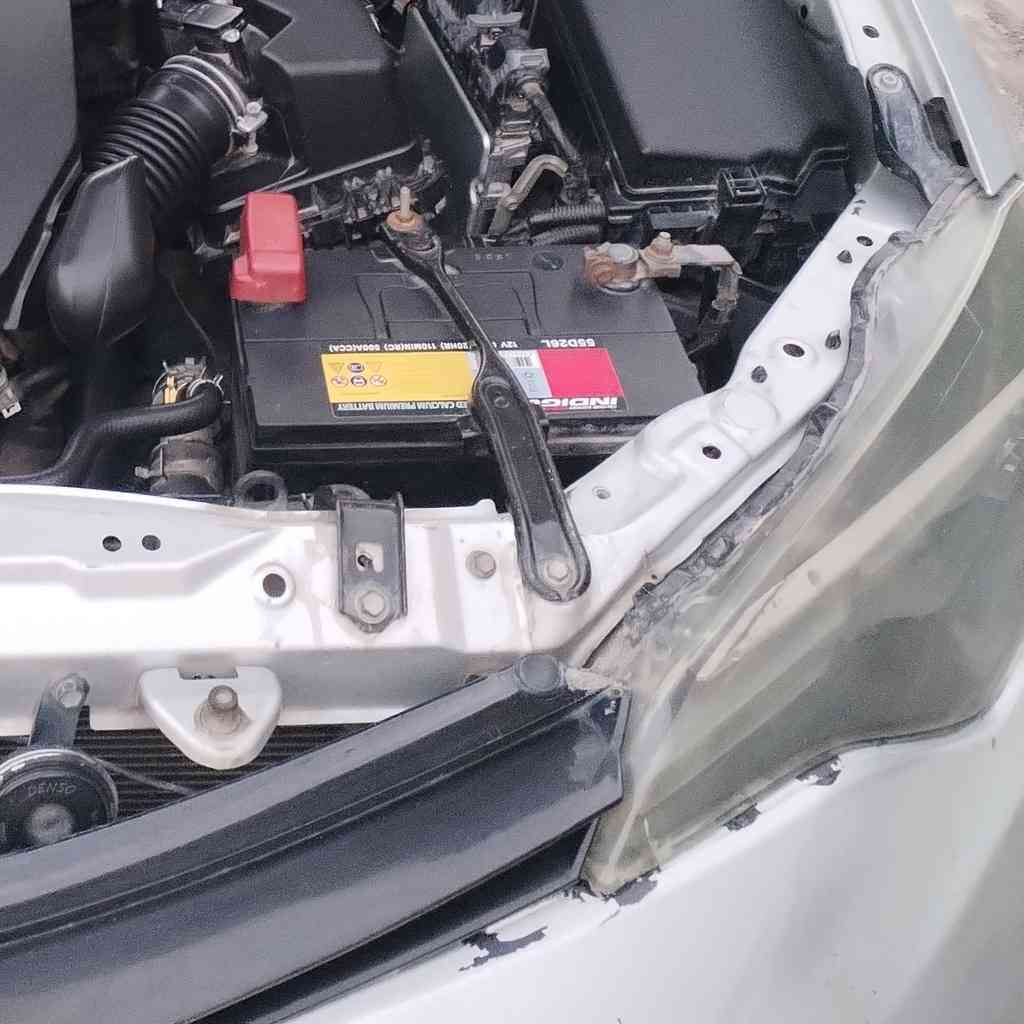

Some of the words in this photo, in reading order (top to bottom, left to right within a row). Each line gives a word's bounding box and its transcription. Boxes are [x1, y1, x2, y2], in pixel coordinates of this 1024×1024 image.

[336, 402, 375, 411] BATTERY
[375, 402, 416, 411] PREMIUM
[416, 401, 455, 410] CALCIUM
